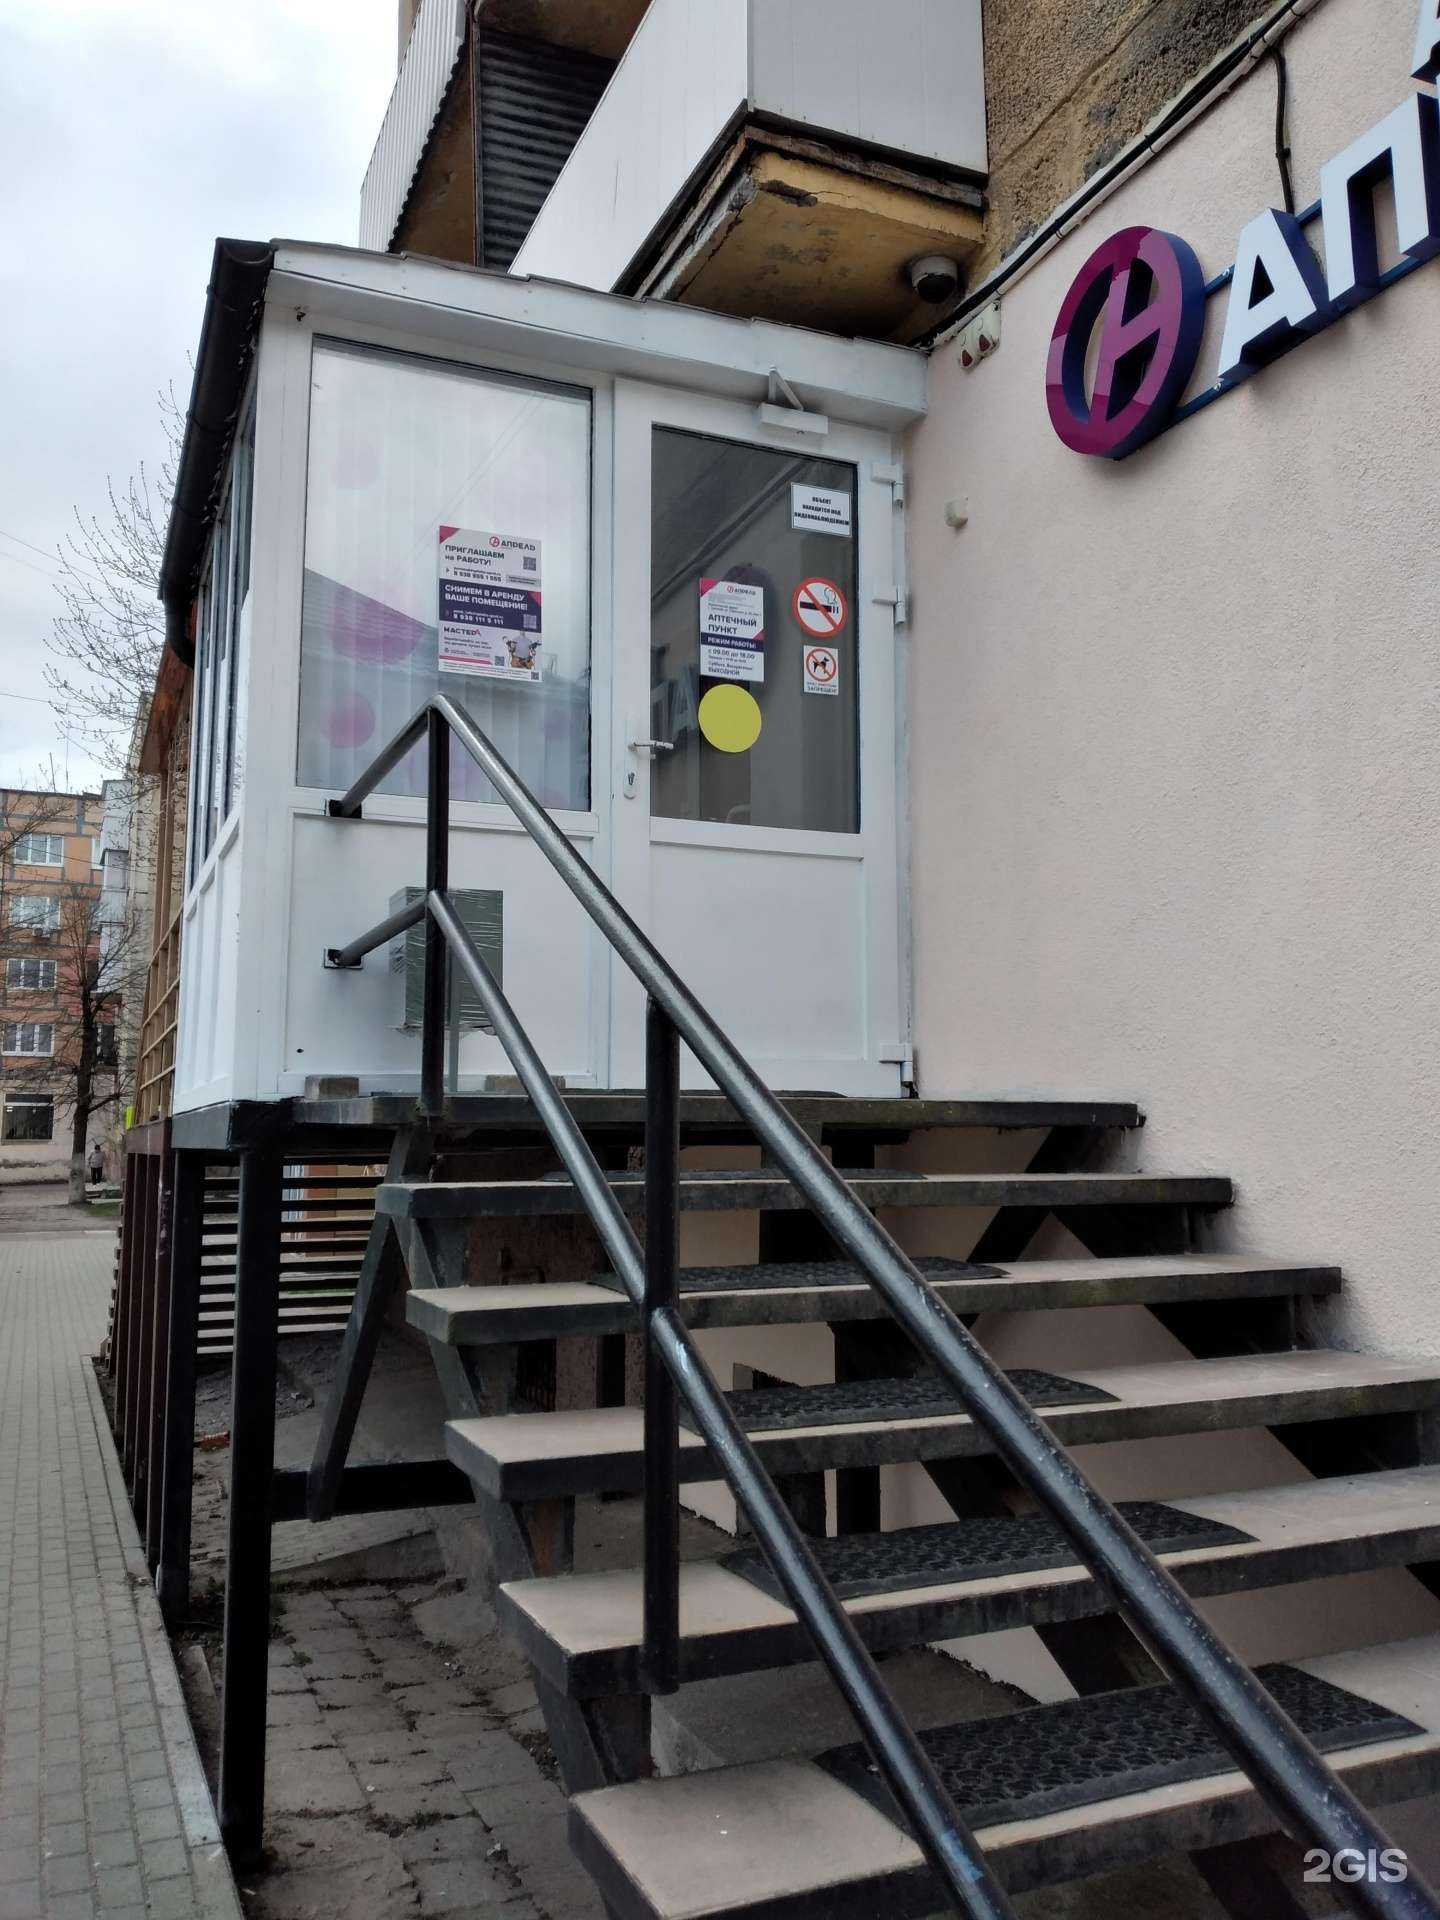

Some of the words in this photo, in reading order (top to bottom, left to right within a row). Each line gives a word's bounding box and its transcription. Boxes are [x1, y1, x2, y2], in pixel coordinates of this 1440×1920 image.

[1217, 76, 1440, 379] АП
[445, 545, 505, 560] ПРИГЛАШАЕМ
[456, 555, 492, 567] РАБОТУ!
[444, 584, 483, 596] СНИМЕМ
[491, 591, 525, 602] АРЕНДУ
[444, 593, 470, 603] ВАШЕ
[471, 596, 528, 611] ПОМЕЩЕНИЕ!
[708, 613, 757, 627] АПТЕЧНЫЙ
[708, 623, 737, 635] ПУНКТ
[708, 636, 730, 645] РЕЖИМ
